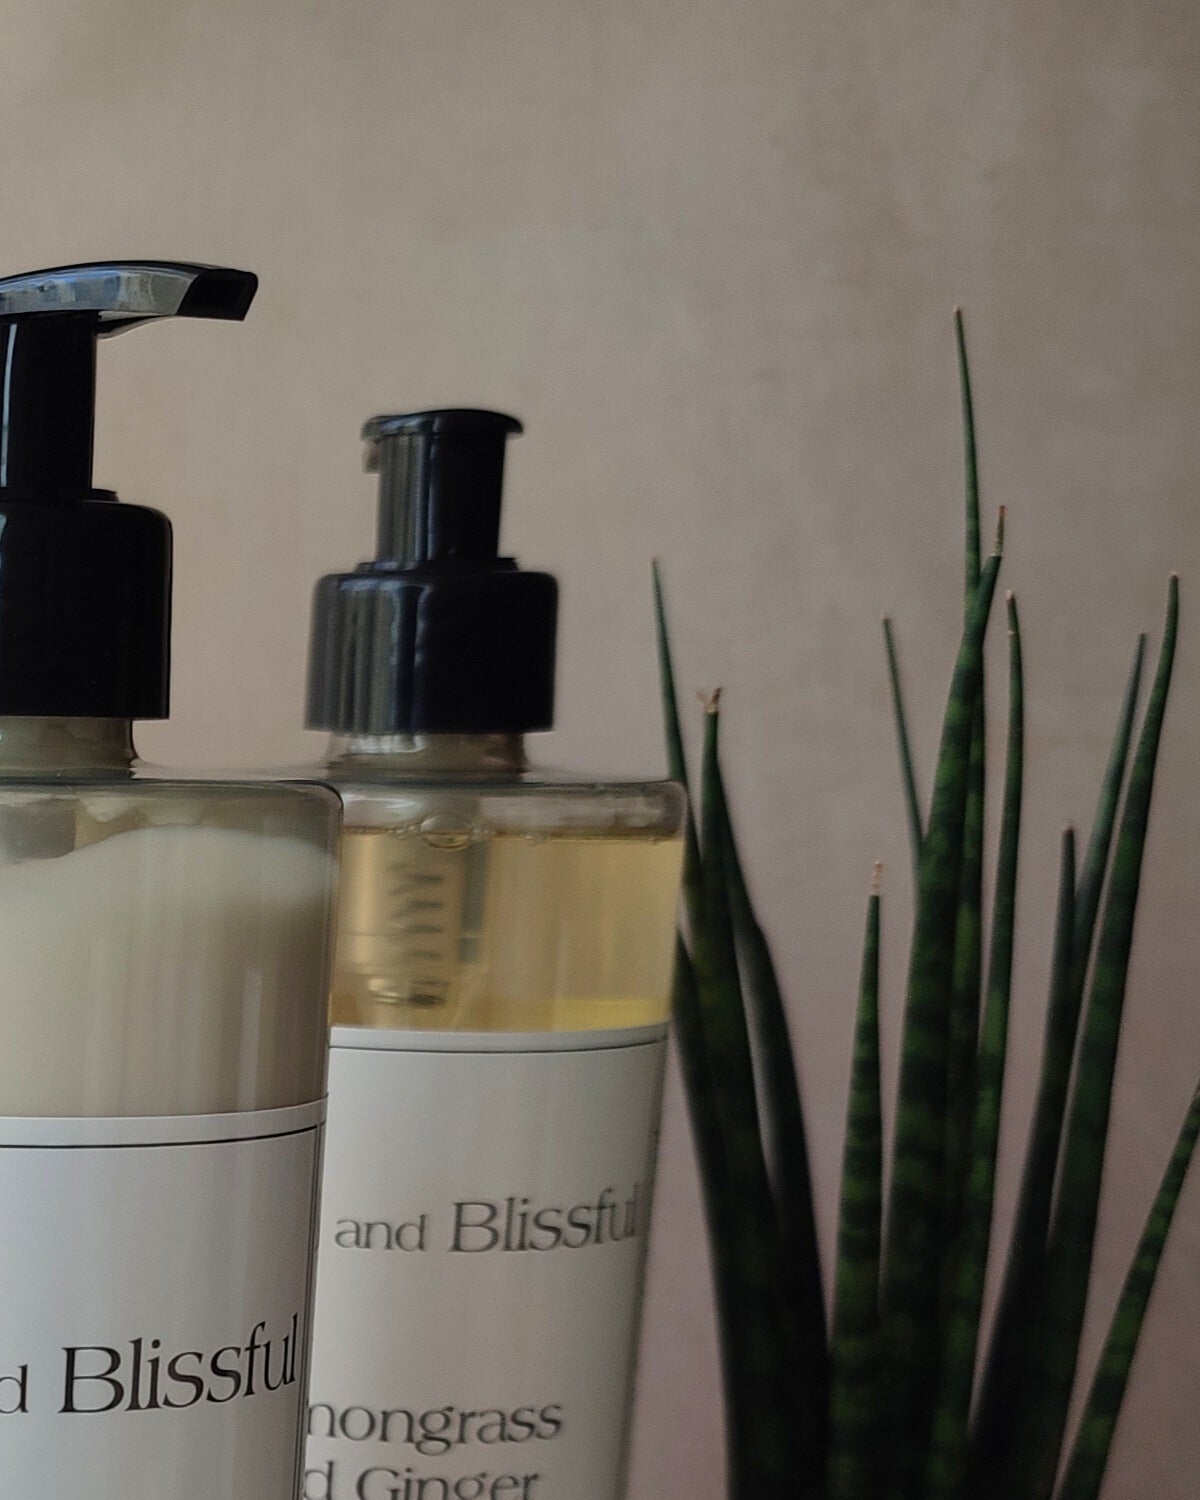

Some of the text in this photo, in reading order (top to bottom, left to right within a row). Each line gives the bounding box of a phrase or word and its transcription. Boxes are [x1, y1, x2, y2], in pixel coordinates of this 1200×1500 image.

[334, 1182, 642, 1254] and Blissful
[58, 1313, 299, 1414] Blissful
